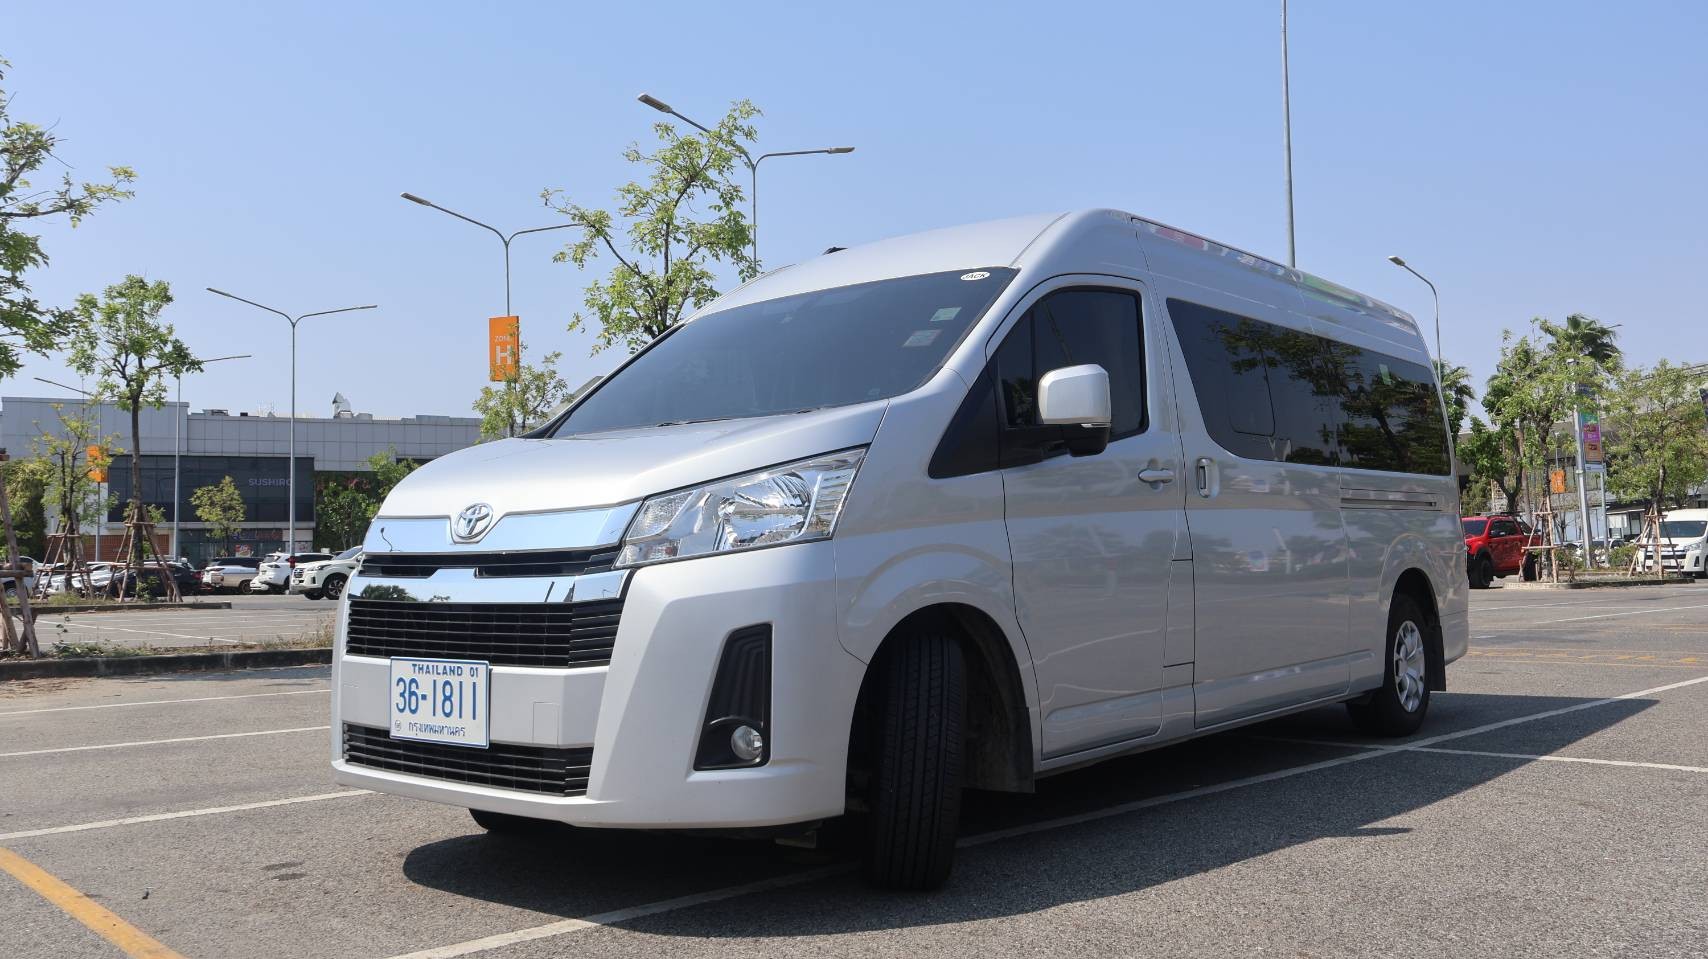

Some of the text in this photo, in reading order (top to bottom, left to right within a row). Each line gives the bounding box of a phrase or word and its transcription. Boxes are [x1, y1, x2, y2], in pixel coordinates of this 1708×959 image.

[495, 345, 513, 365] H
[411, 664, 479, 678] THAILAND 01
[396, 677, 477, 720] 36-1811
[408, 722, 466, 736] กรุงเทพมหานคร
